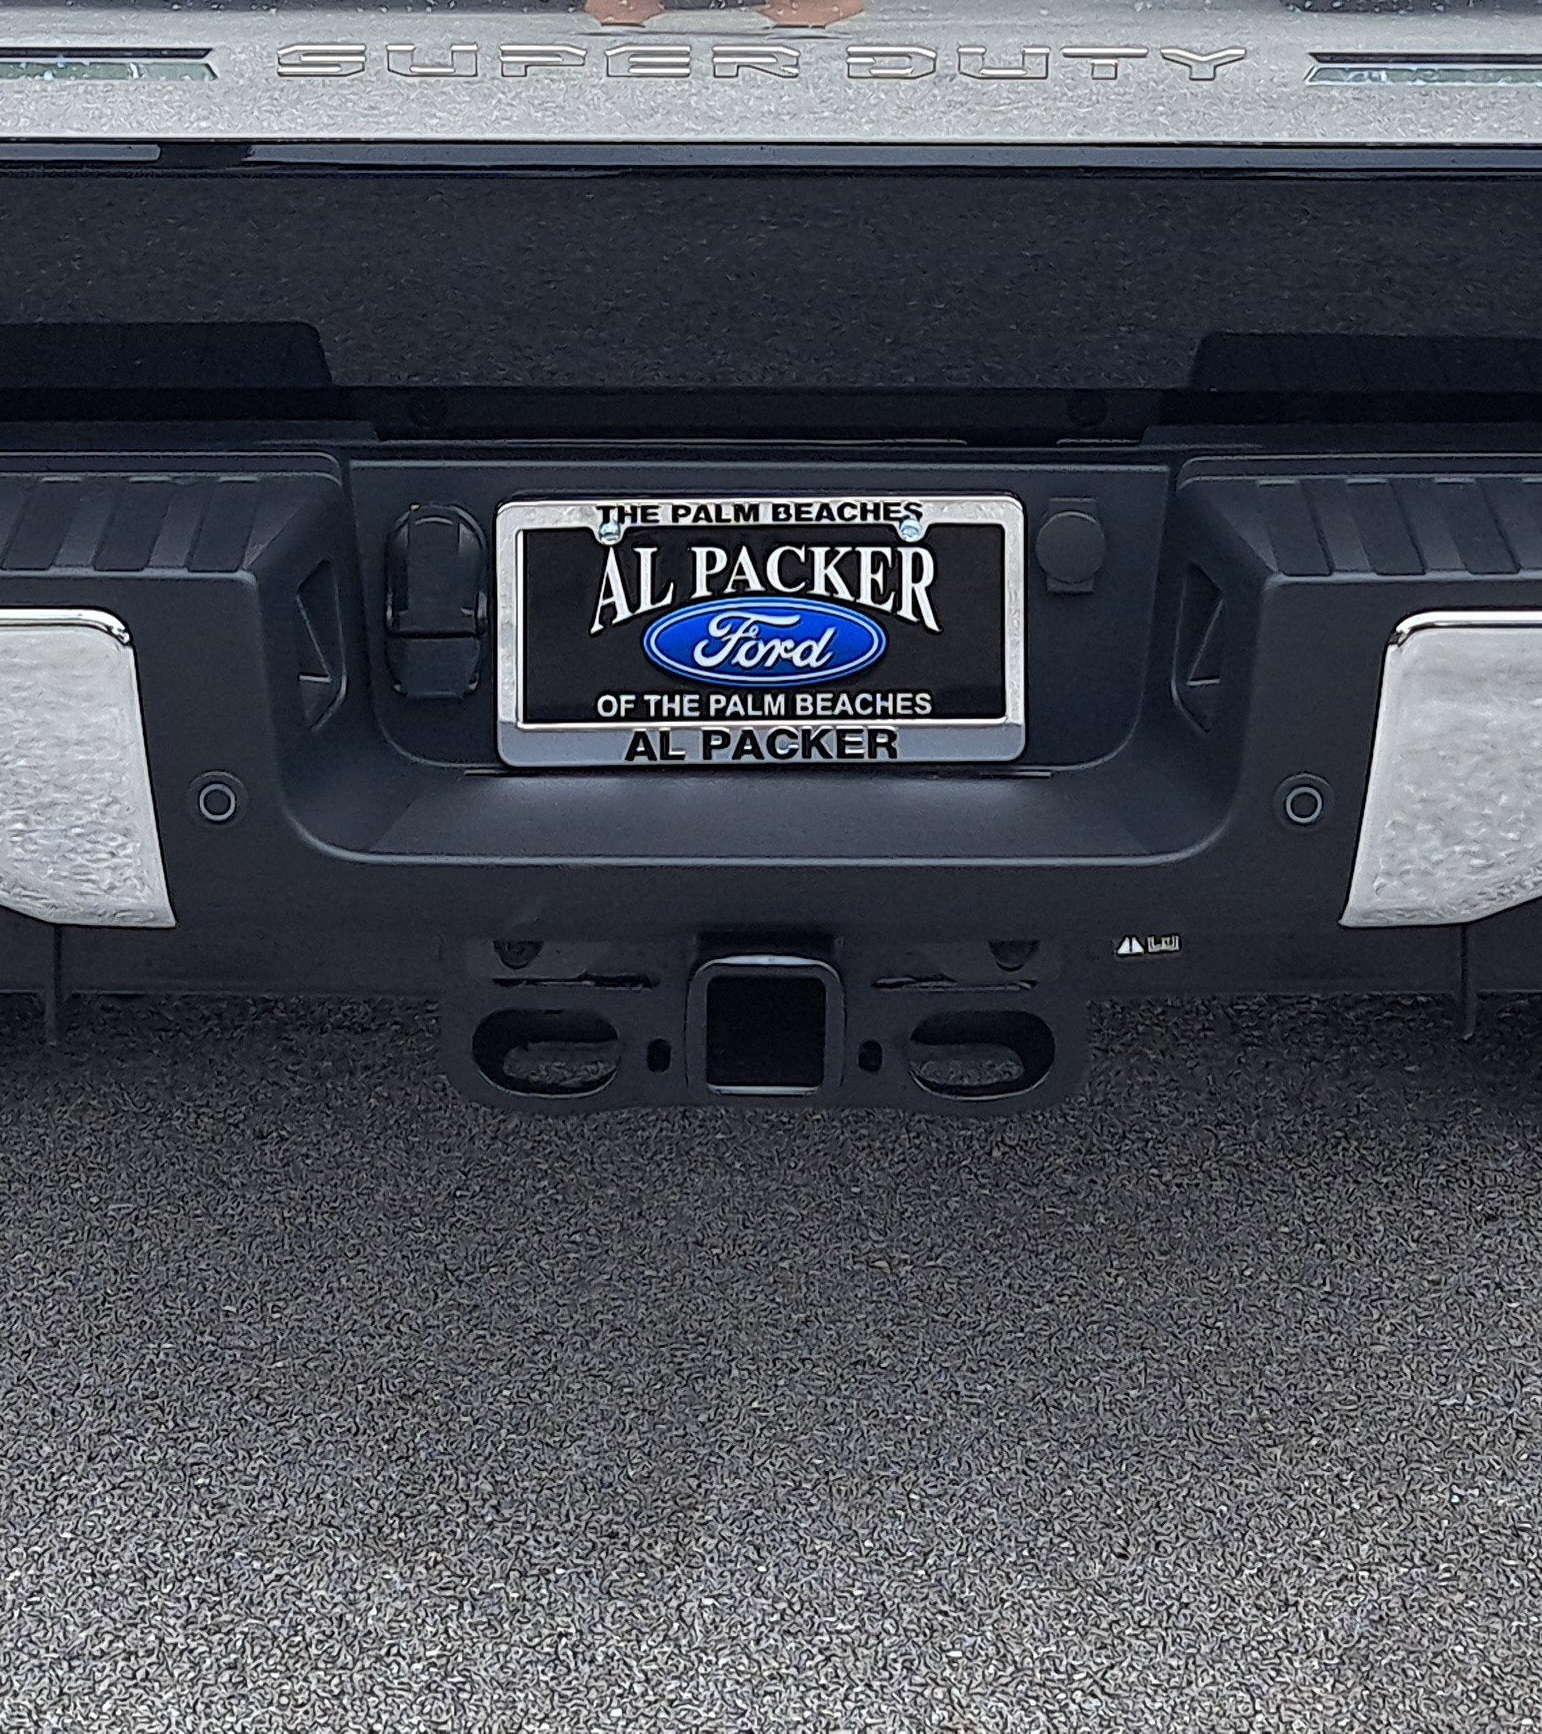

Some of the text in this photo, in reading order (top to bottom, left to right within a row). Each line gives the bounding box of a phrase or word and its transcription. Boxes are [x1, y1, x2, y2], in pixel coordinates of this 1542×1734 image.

[276, 43, 1247, 81] SUPER DUTY
[596, 501, 924, 524] THE PALM BEACHES
[590, 545, 942, 635] AL PACKER
[692, 610, 835, 670] Ford
[596, 692, 933, 718] OF THE PALM BEACHES
[624, 726, 898, 762] AL PACKER
